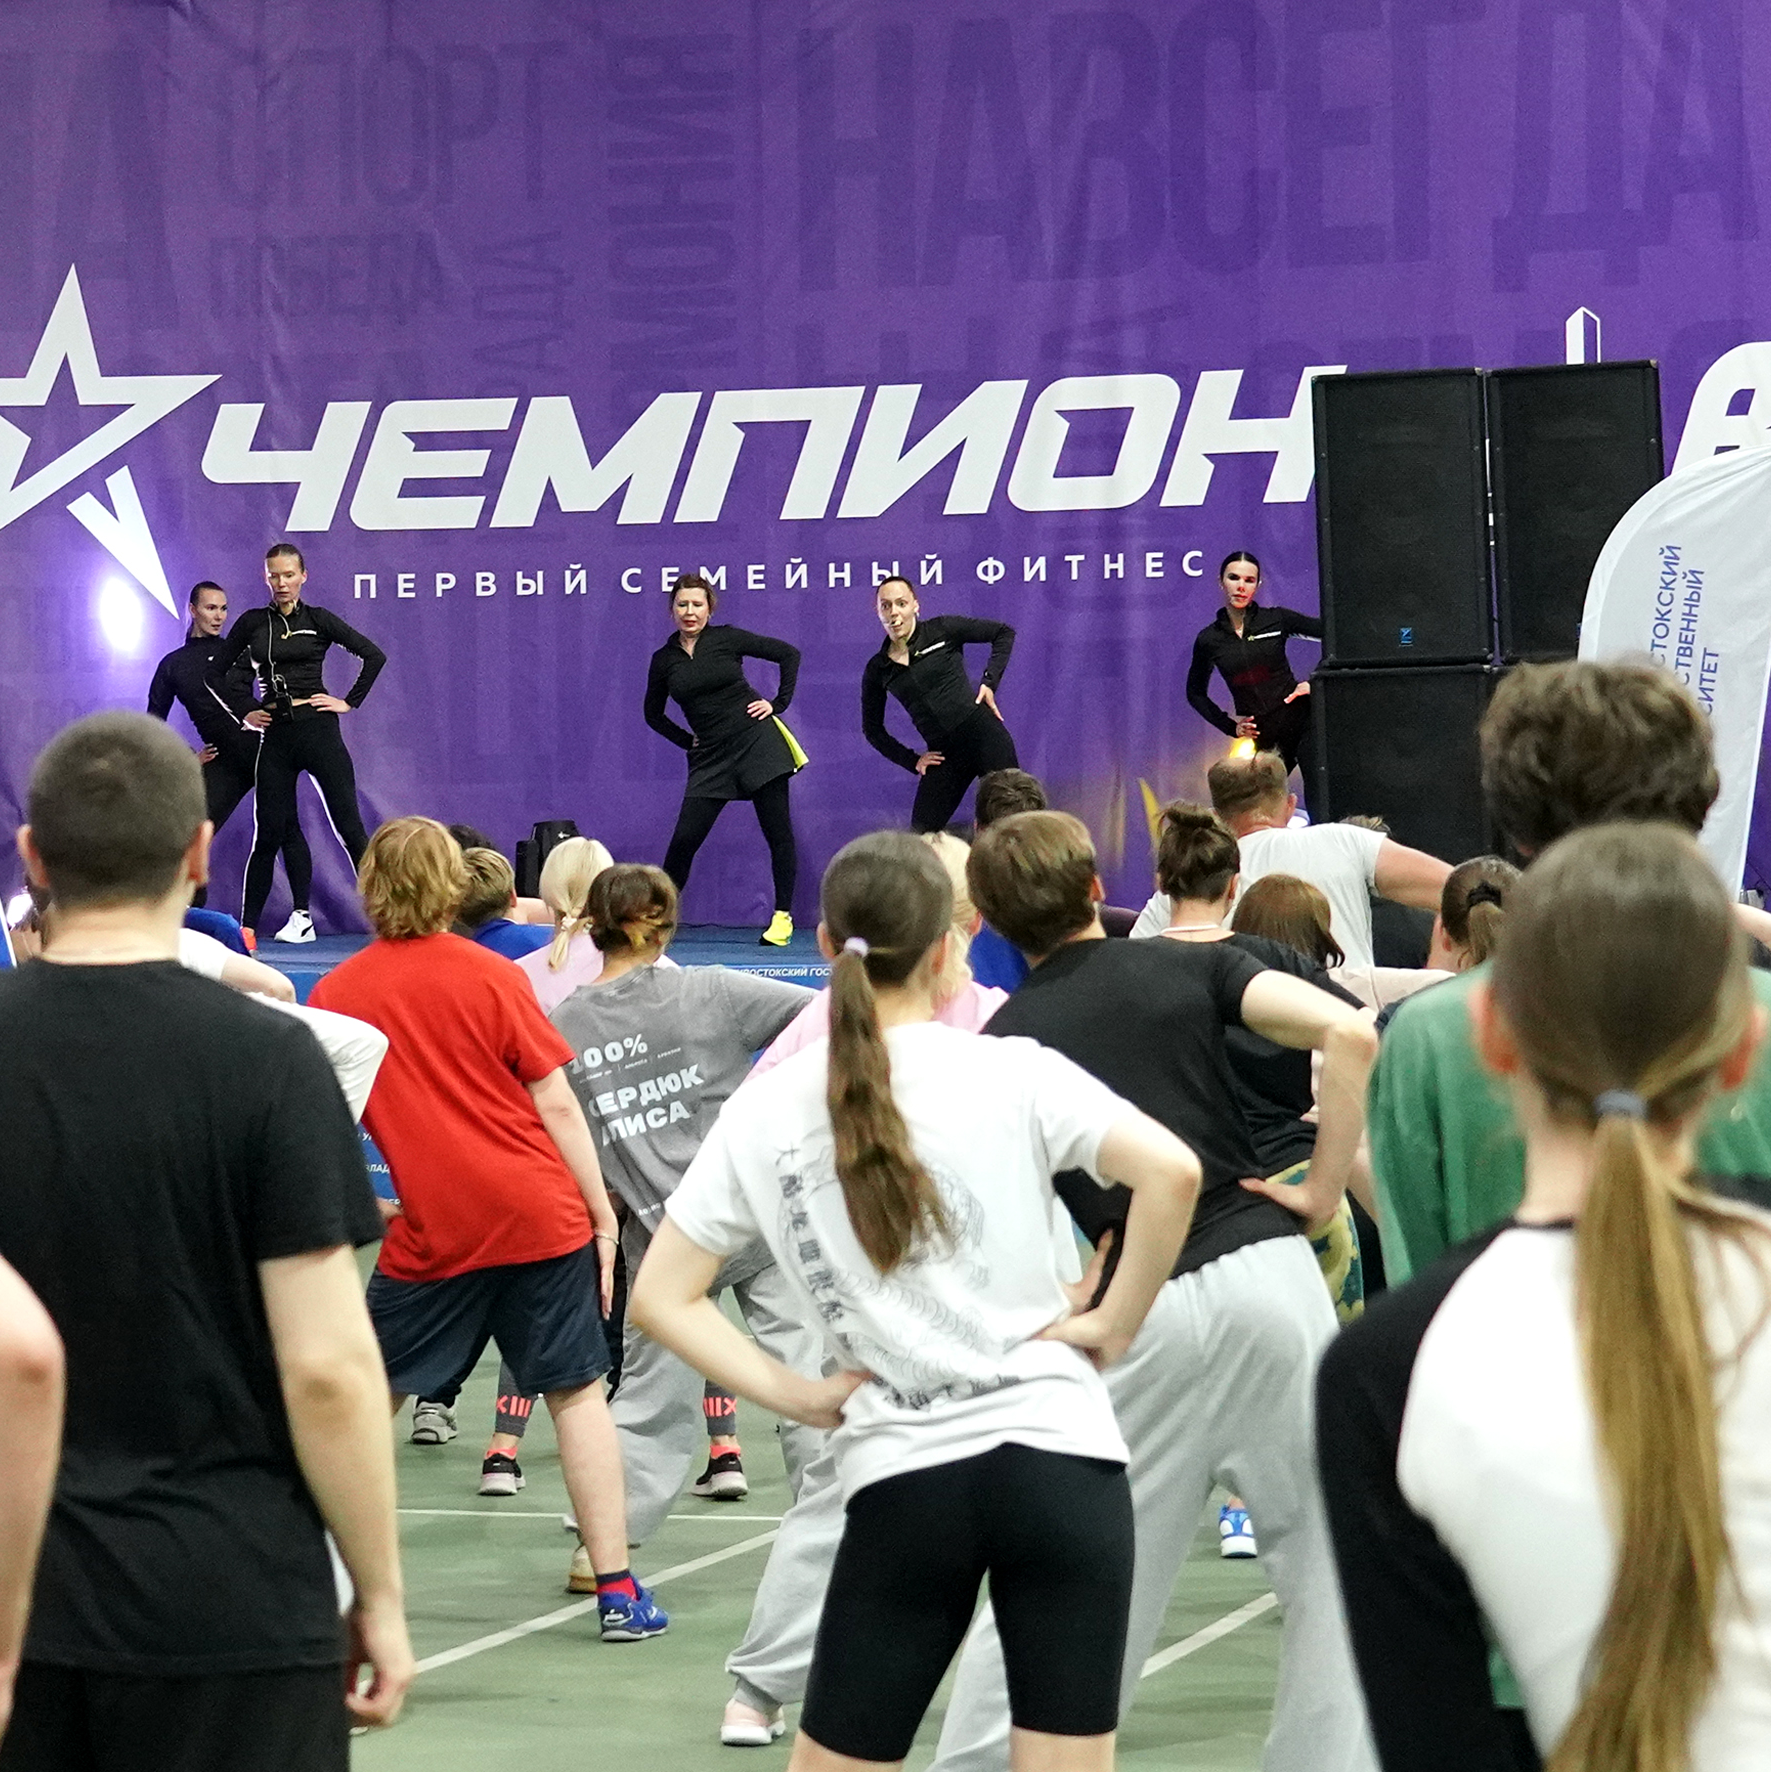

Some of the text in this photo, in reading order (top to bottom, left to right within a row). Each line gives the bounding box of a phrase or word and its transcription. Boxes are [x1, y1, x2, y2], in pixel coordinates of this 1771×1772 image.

[201, 364, 1348, 532] ЧЕМПИОН
[354, 550, 1204, 599] ПЕРВЫЙ СЕМЕЙНЫЙ ФИТНЕС
[569, 1033, 648, 1075] 100%
